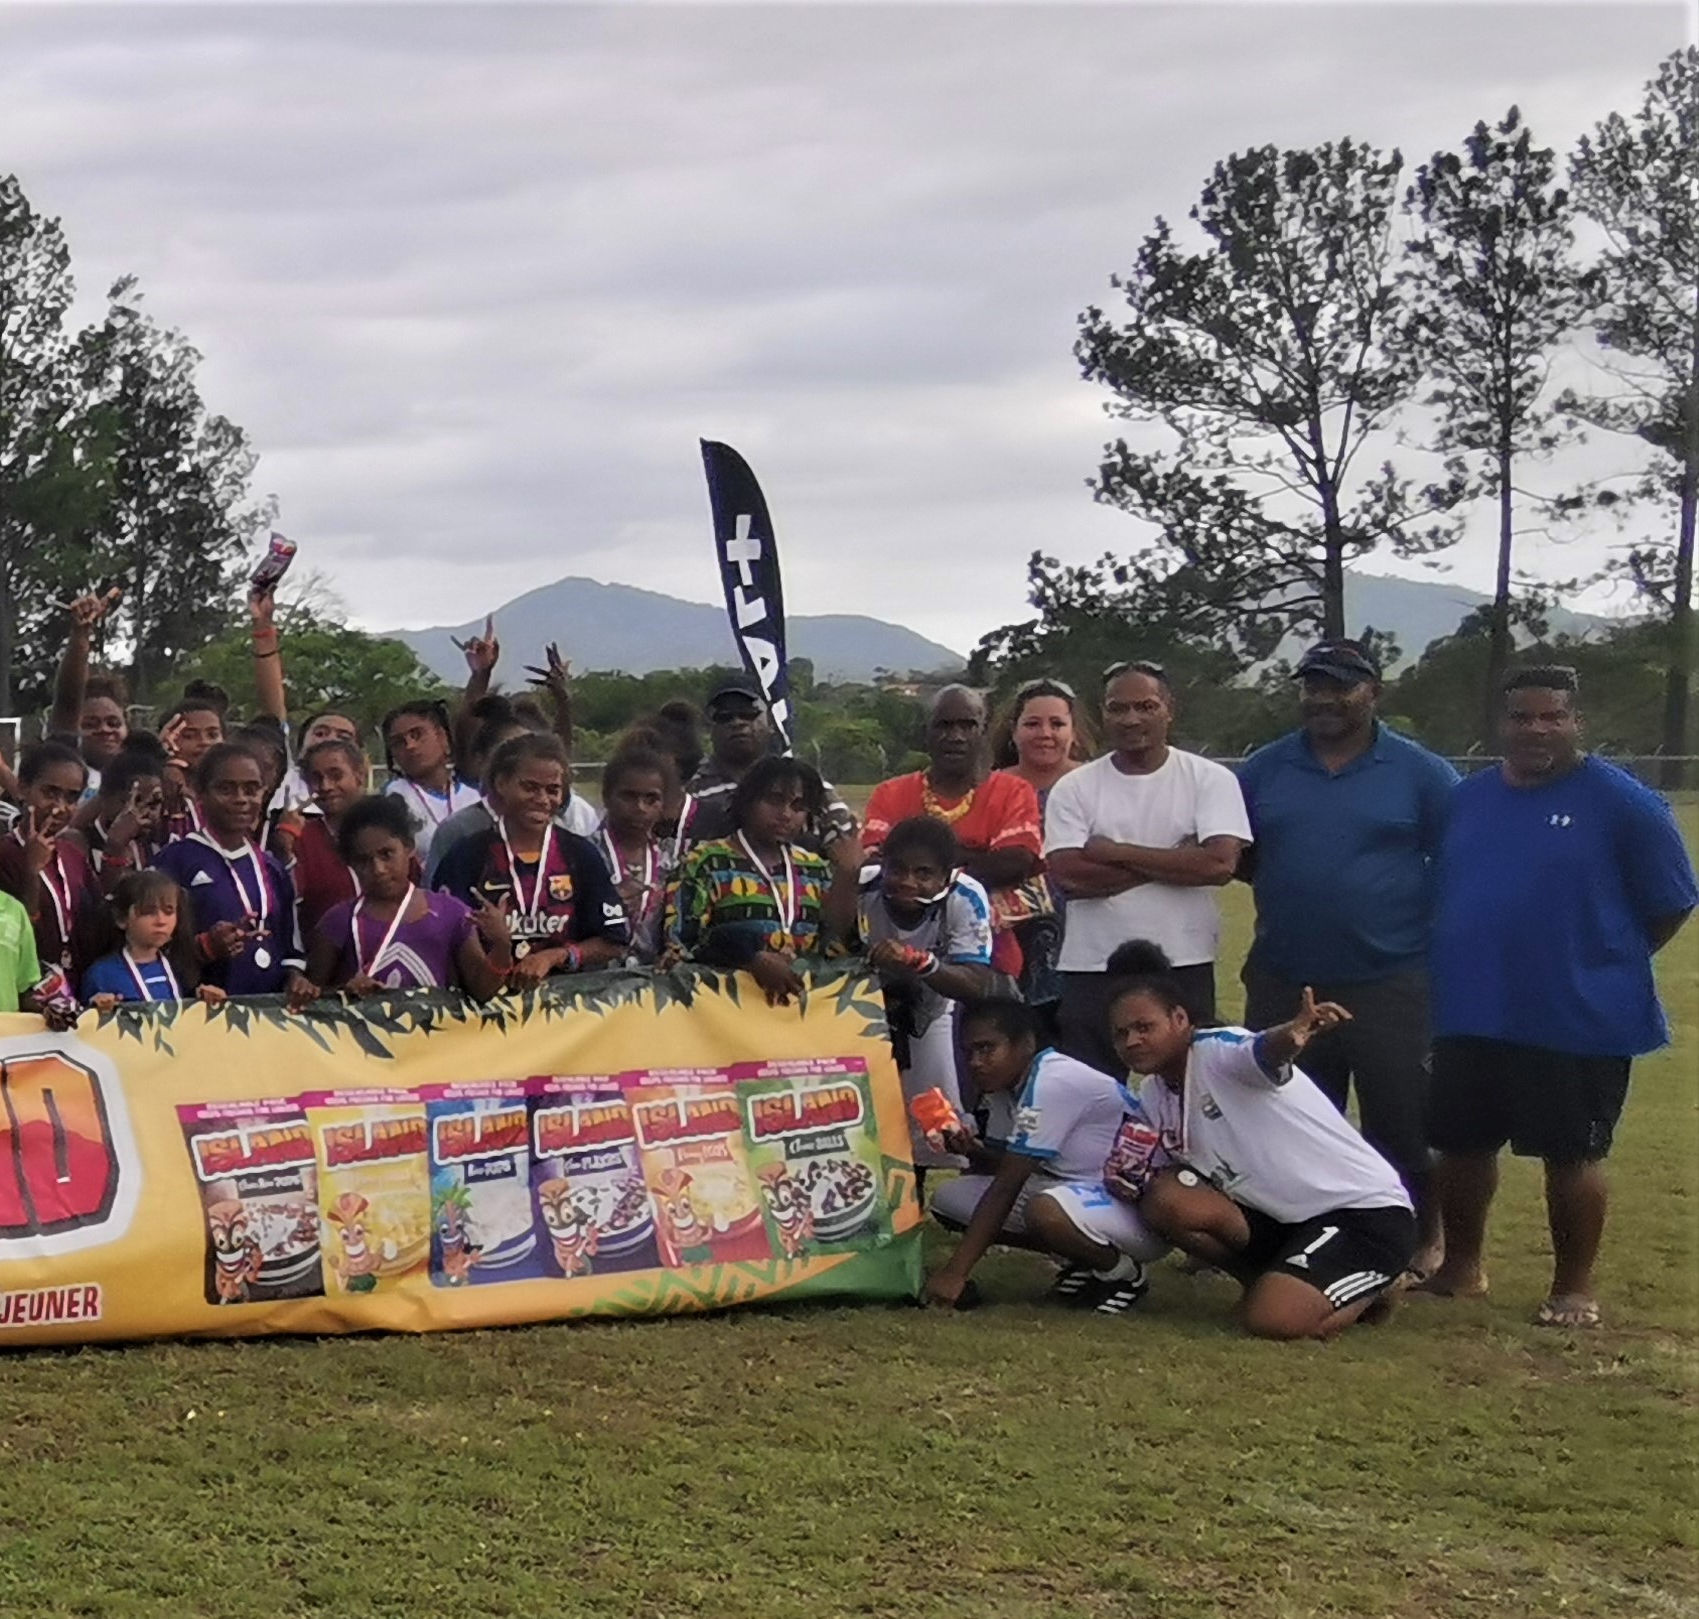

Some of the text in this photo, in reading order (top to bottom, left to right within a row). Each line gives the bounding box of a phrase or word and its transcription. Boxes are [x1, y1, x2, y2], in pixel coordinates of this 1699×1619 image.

[438, 1110, 528, 1161] ISLAND
[538, 1103, 634, 1156] ISLAND
[638, 1098, 742, 1146] ISLAND
[753, 1086, 861, 1138] ISLAND
[196, 1123, 316, 1177] ISLAND
[323, 1116, 427, 1168] ISLAND
[1304, 1226, 1339, 1254] 1
